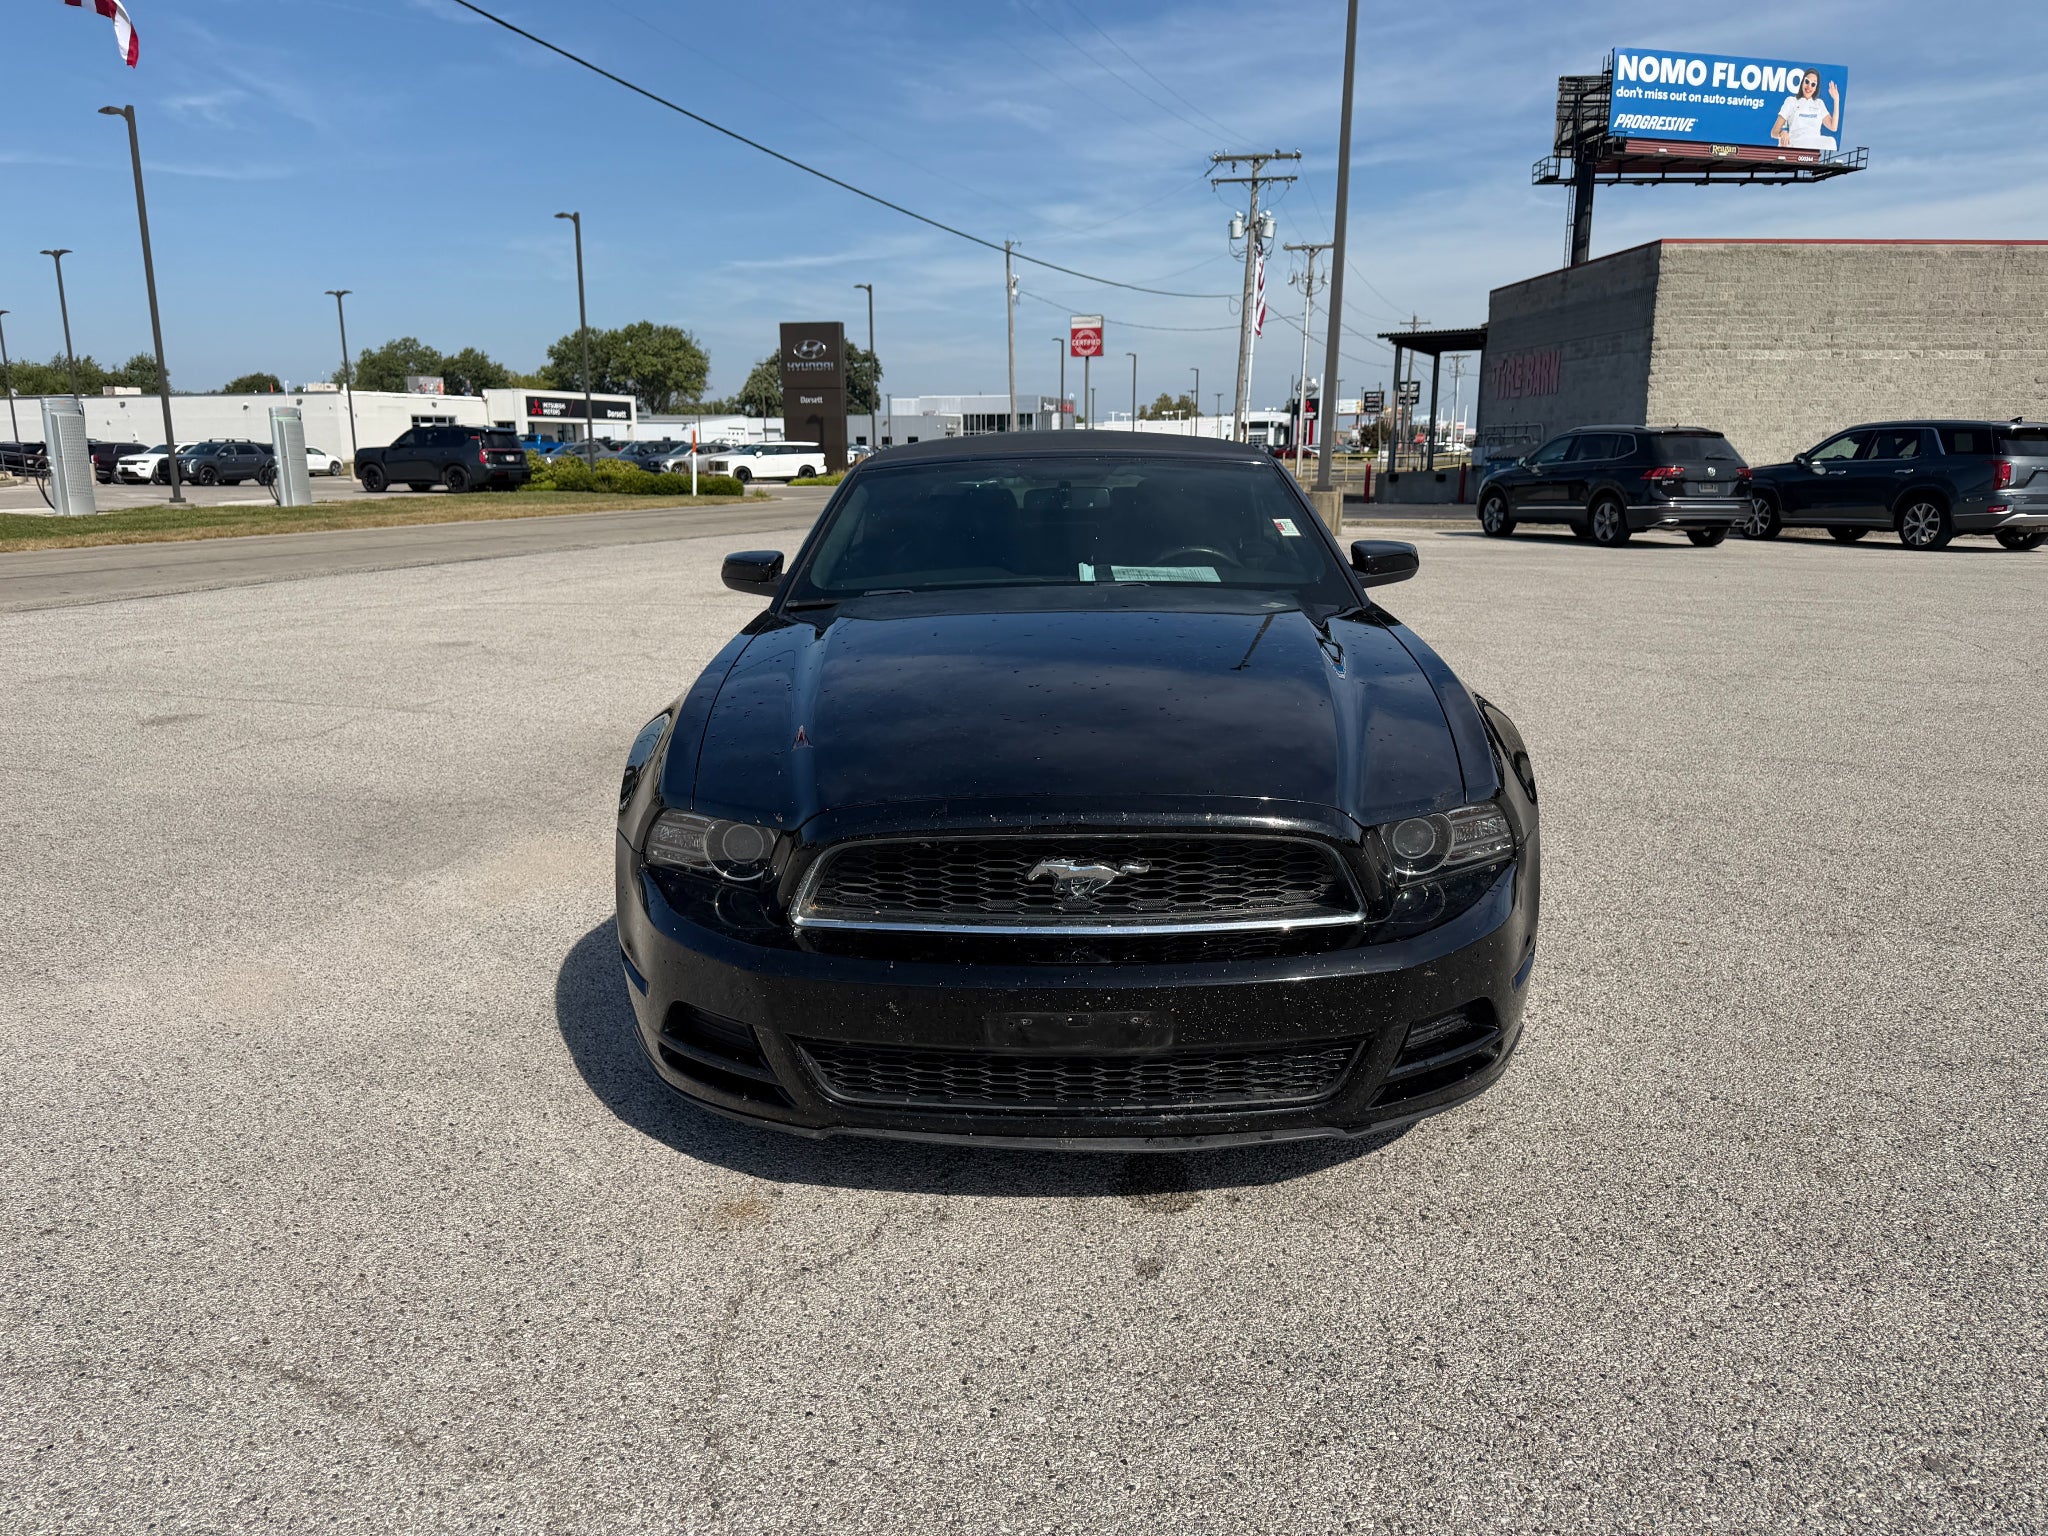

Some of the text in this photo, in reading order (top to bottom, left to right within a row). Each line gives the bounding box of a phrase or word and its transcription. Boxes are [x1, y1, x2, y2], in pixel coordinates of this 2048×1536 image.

[1617, 54, 1805, 94] NOMO FLOMO
[1616, 86, 1765, 110] don't miss out on auto savings
[1613, 113, 1696, 132] PROGRESSIVE
[1712, 145, 1737, 155] Reagan
[787, 362, 834, 372] HYUNDAI
[800, 396, 823, 404] Dorsett
